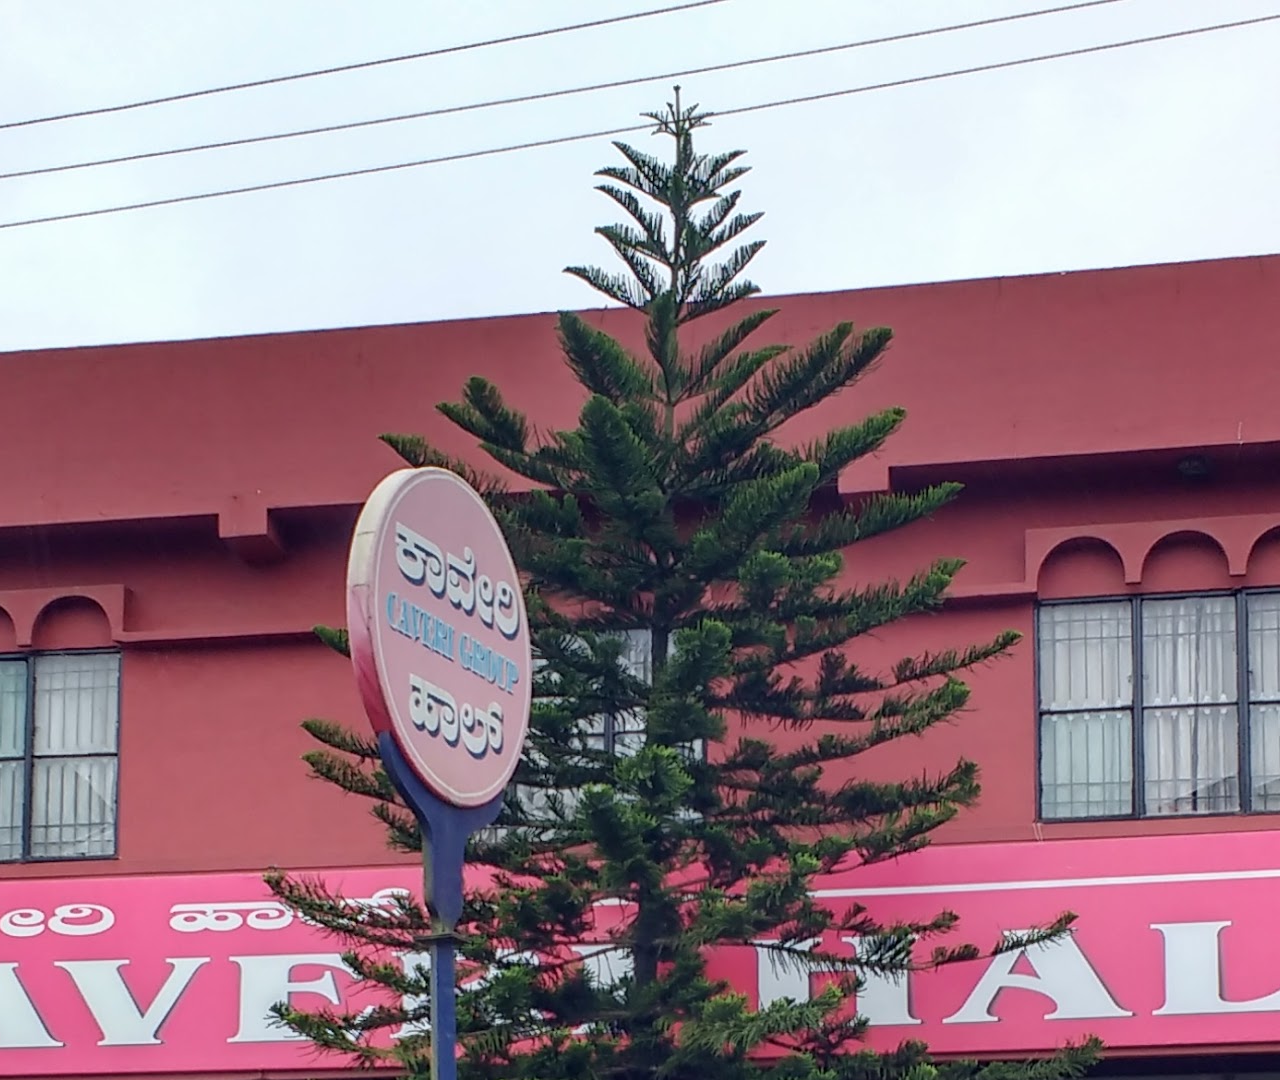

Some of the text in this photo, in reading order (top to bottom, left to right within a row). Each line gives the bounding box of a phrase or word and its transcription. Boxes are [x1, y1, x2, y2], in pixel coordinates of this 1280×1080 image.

[396, 521, 519, 640] ಕಾವೇರಿ
[386, 591, 520, 695] CAVERI GROUP
[409, 672, 504, 760] ಹಾಲ್
